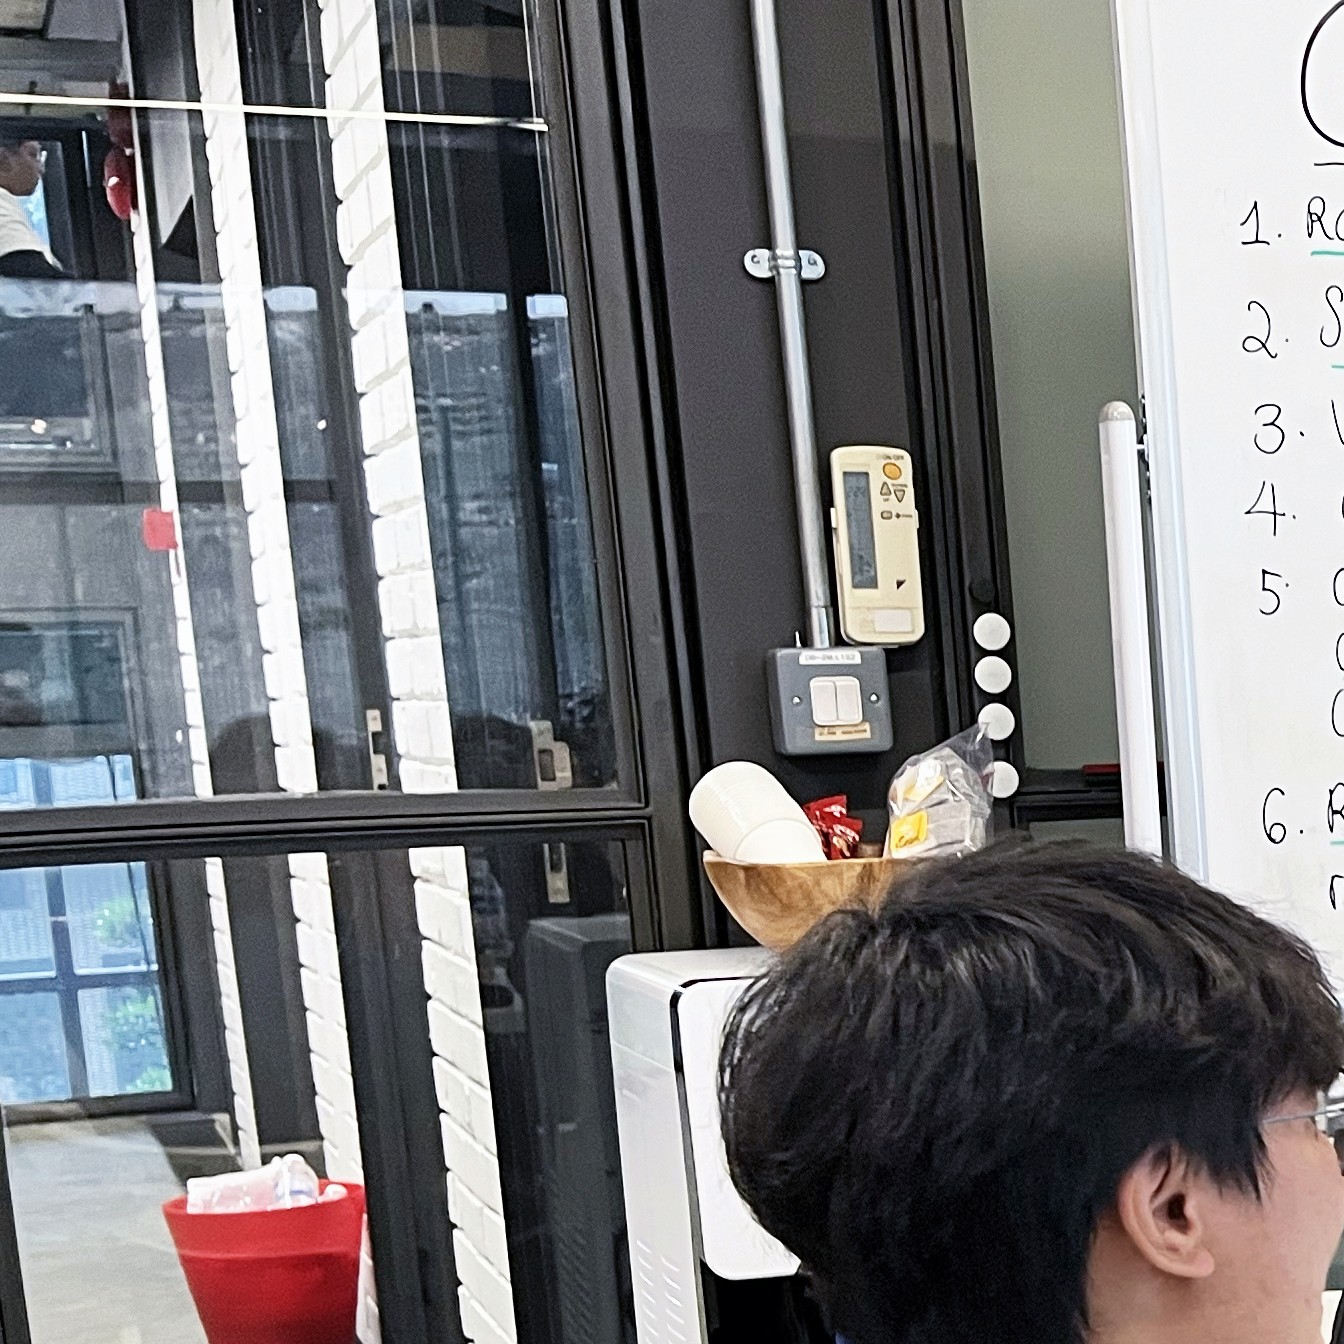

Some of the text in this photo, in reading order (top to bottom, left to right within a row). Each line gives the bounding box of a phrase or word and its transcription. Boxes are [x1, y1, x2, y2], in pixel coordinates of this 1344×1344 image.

[1240, 200, 1281, 245] 1.
[1242, 301, 1288, 359] 2.
[1254, 404, 1304, 454] 3.
[1244, 481, 1296, 536] 4.
[1263, 788, 1303, 844] 6.
